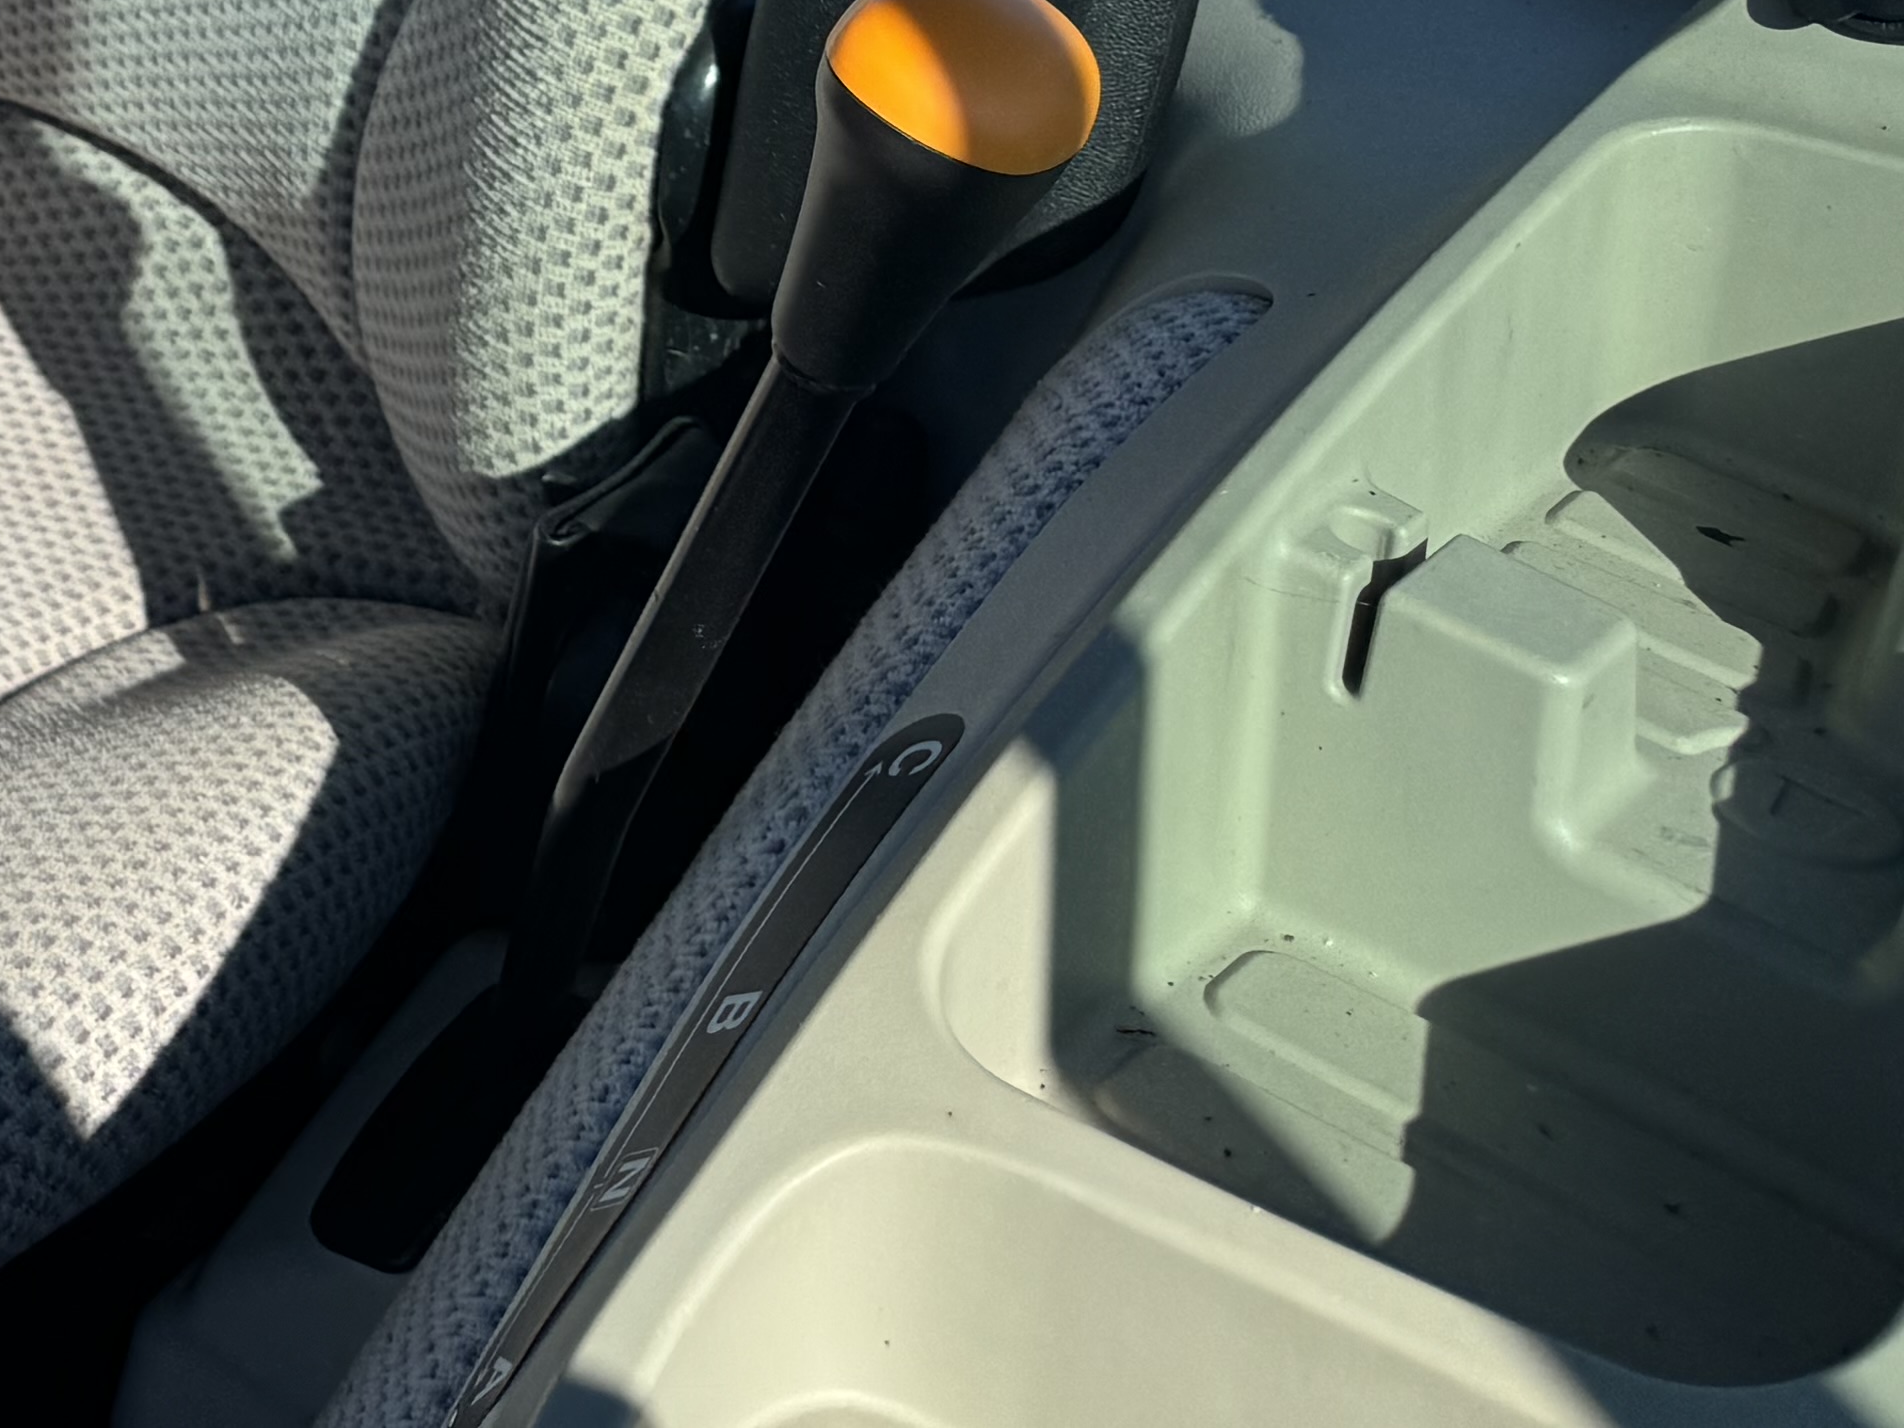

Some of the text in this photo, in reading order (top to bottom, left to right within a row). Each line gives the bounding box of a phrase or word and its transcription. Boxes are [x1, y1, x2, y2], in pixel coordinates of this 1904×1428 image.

[888, 740, 942, 777] C
[706, 990, 763, 1034] B
[598, 1156, 651, 1203] N
[470, 1355, 512, 1406] A
